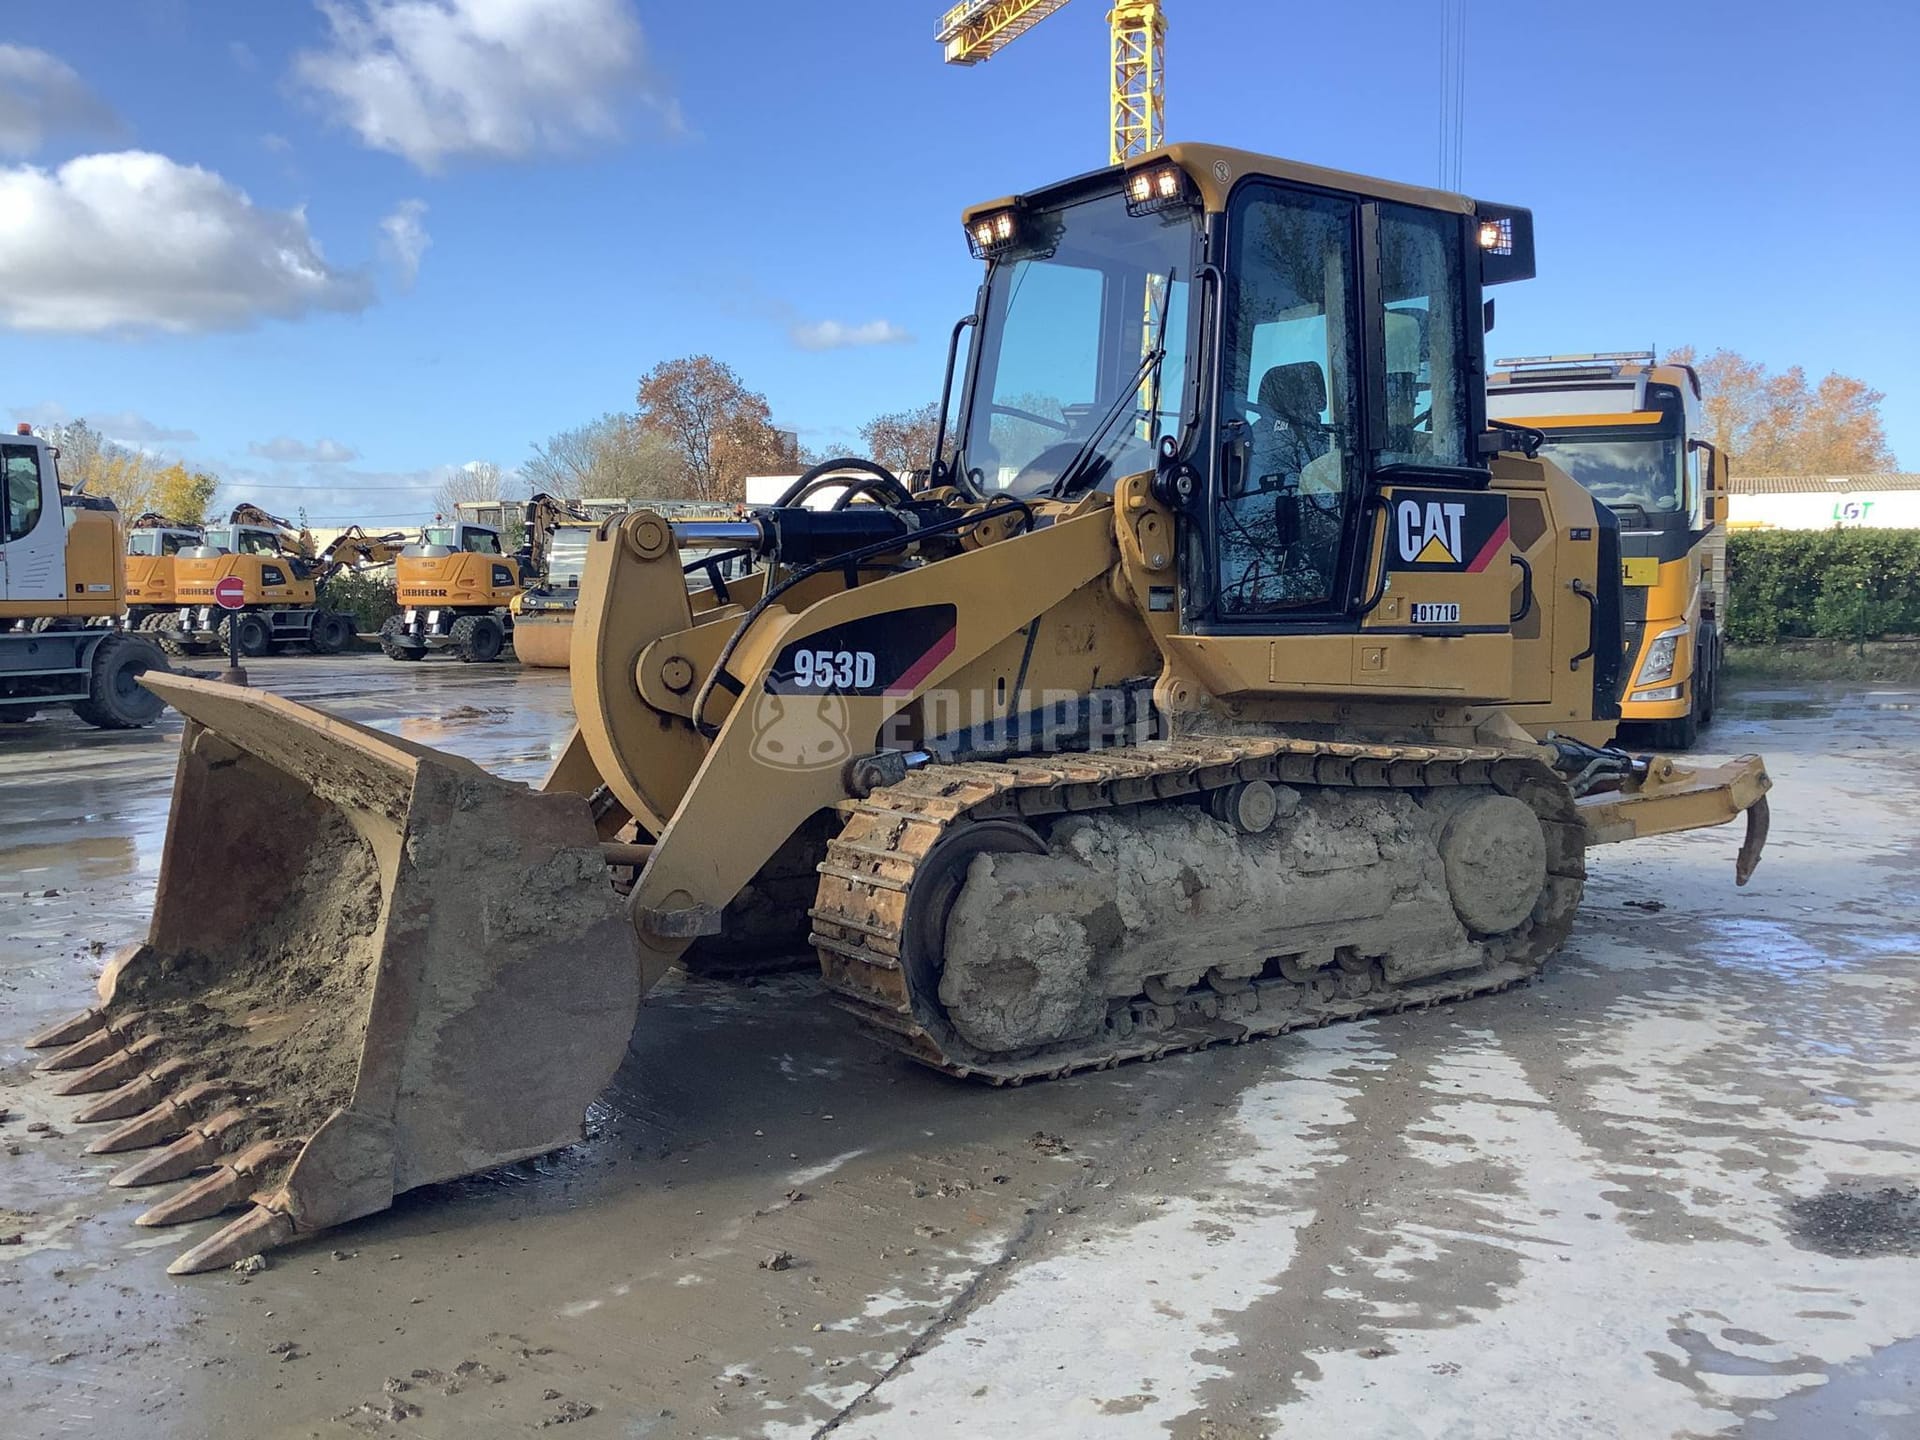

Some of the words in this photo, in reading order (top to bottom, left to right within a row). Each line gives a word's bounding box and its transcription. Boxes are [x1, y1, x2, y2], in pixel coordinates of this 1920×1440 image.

[1833, 502, 1874, 520] LGT
[1398, 500, 1465, 563] CAT
[402, 588, 448, 597] LIEBHERR
[1420, 604, 1457, 621] 01710
[793, 649, 876, 688] 953D
